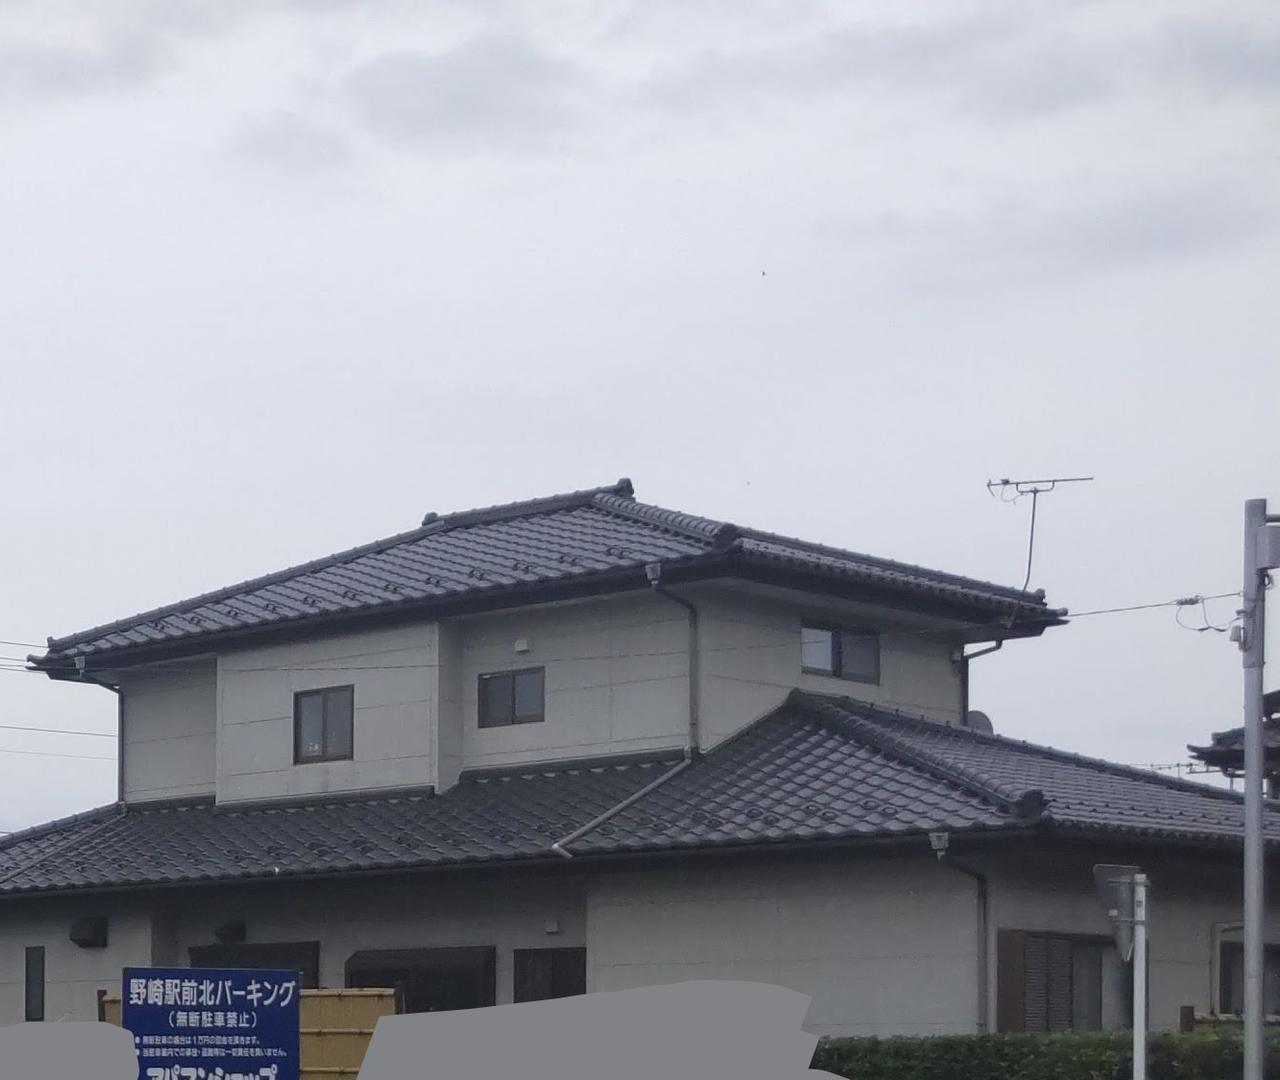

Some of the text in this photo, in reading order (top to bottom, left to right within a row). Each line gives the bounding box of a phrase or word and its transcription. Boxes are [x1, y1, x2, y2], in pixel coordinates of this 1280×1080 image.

[130, 979, 296, 1007] 野崎駅前北パーキング
